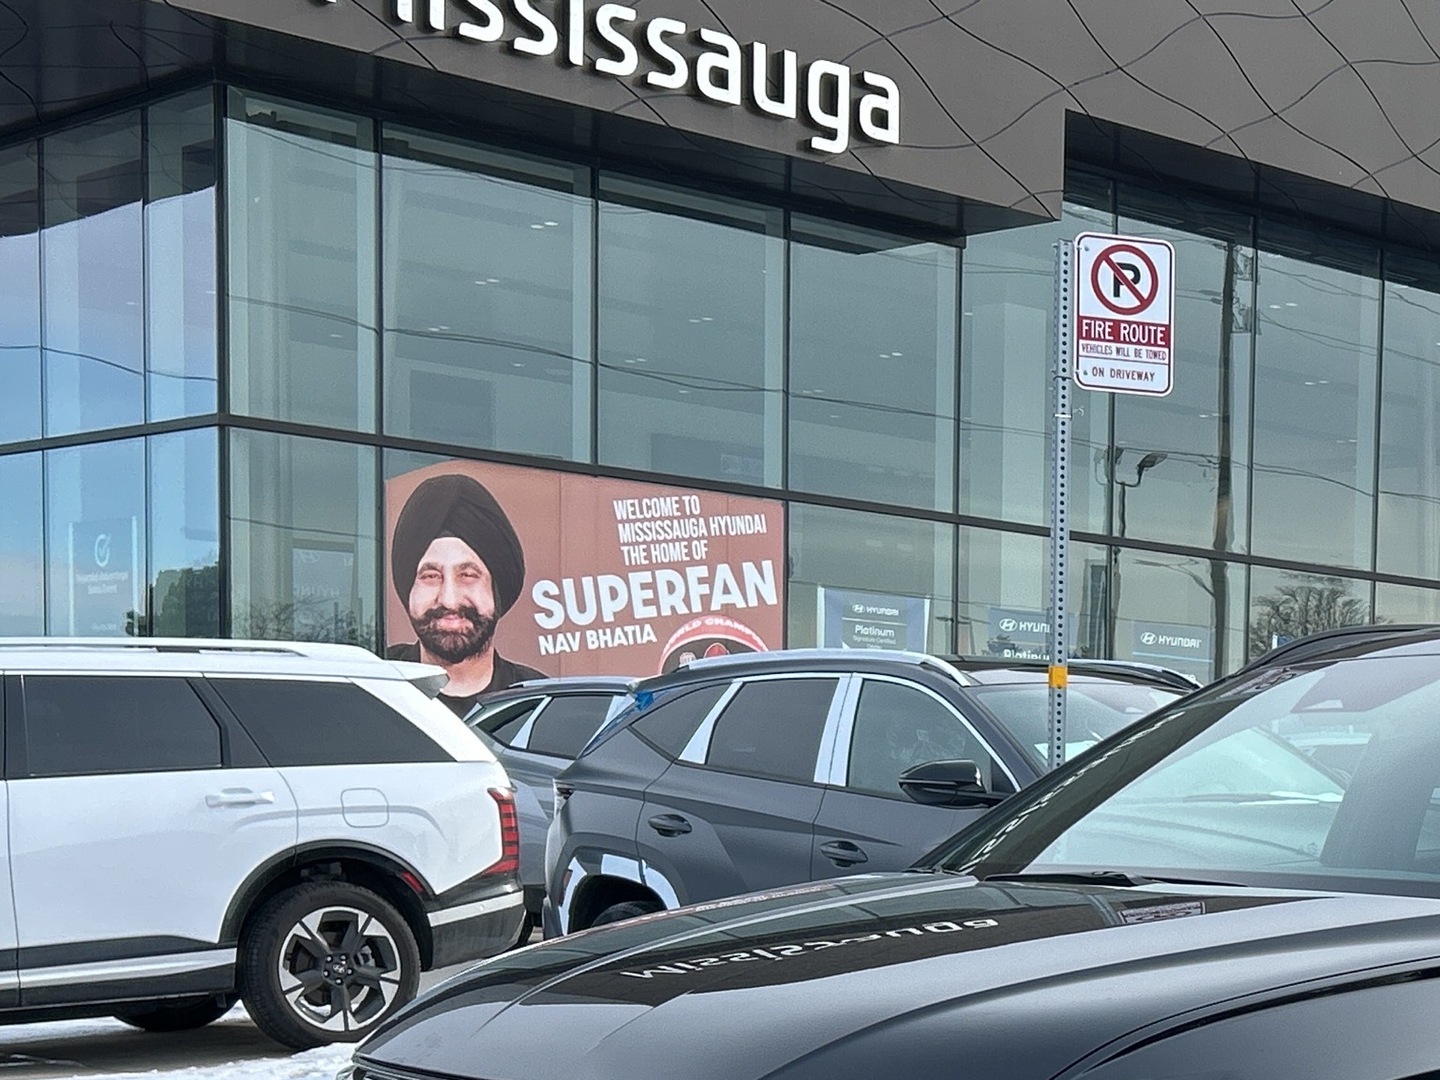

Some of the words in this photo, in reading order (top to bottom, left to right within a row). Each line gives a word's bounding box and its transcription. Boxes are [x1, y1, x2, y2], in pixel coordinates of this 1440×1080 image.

[322, 0, 901, 154] ssissauga
[1082, 319, 1114, 341] FIRE
[1120, 323, 1166, 345] ROUTE
[1081, 343, 1113, 356] VEHICLES
[1115, 346, 1130, 358] WILL
[1134, 348, 1143, 359] BE
[1145, 350, 1167, 362] TOWED
[1092, 366, 1105, 378] ON
[1110, 368, 1155, 382] DRIVEWAY
[613, 496, 681, 520] WELCOME
[681, 495, 701, 516] TO
[617, 517, 708, 543] MISSISSAUGA
[709, 514, 767, 537] HYUNDAI
[621, 545, 649, 566] THE
[650, 542, 690, 564] HOME
[692, 540, 709, 560] OF
[532, 559, 778, 630] SUPERFAN
[538, 630, 581, 656] NAV
[586, 623, 658, 651] BHATIA
[855, 624, 895, 638] Platinum
[1019, 622, 1050, 634] HYUN
[1158, 634, 1202, 649] HYUNDAI
